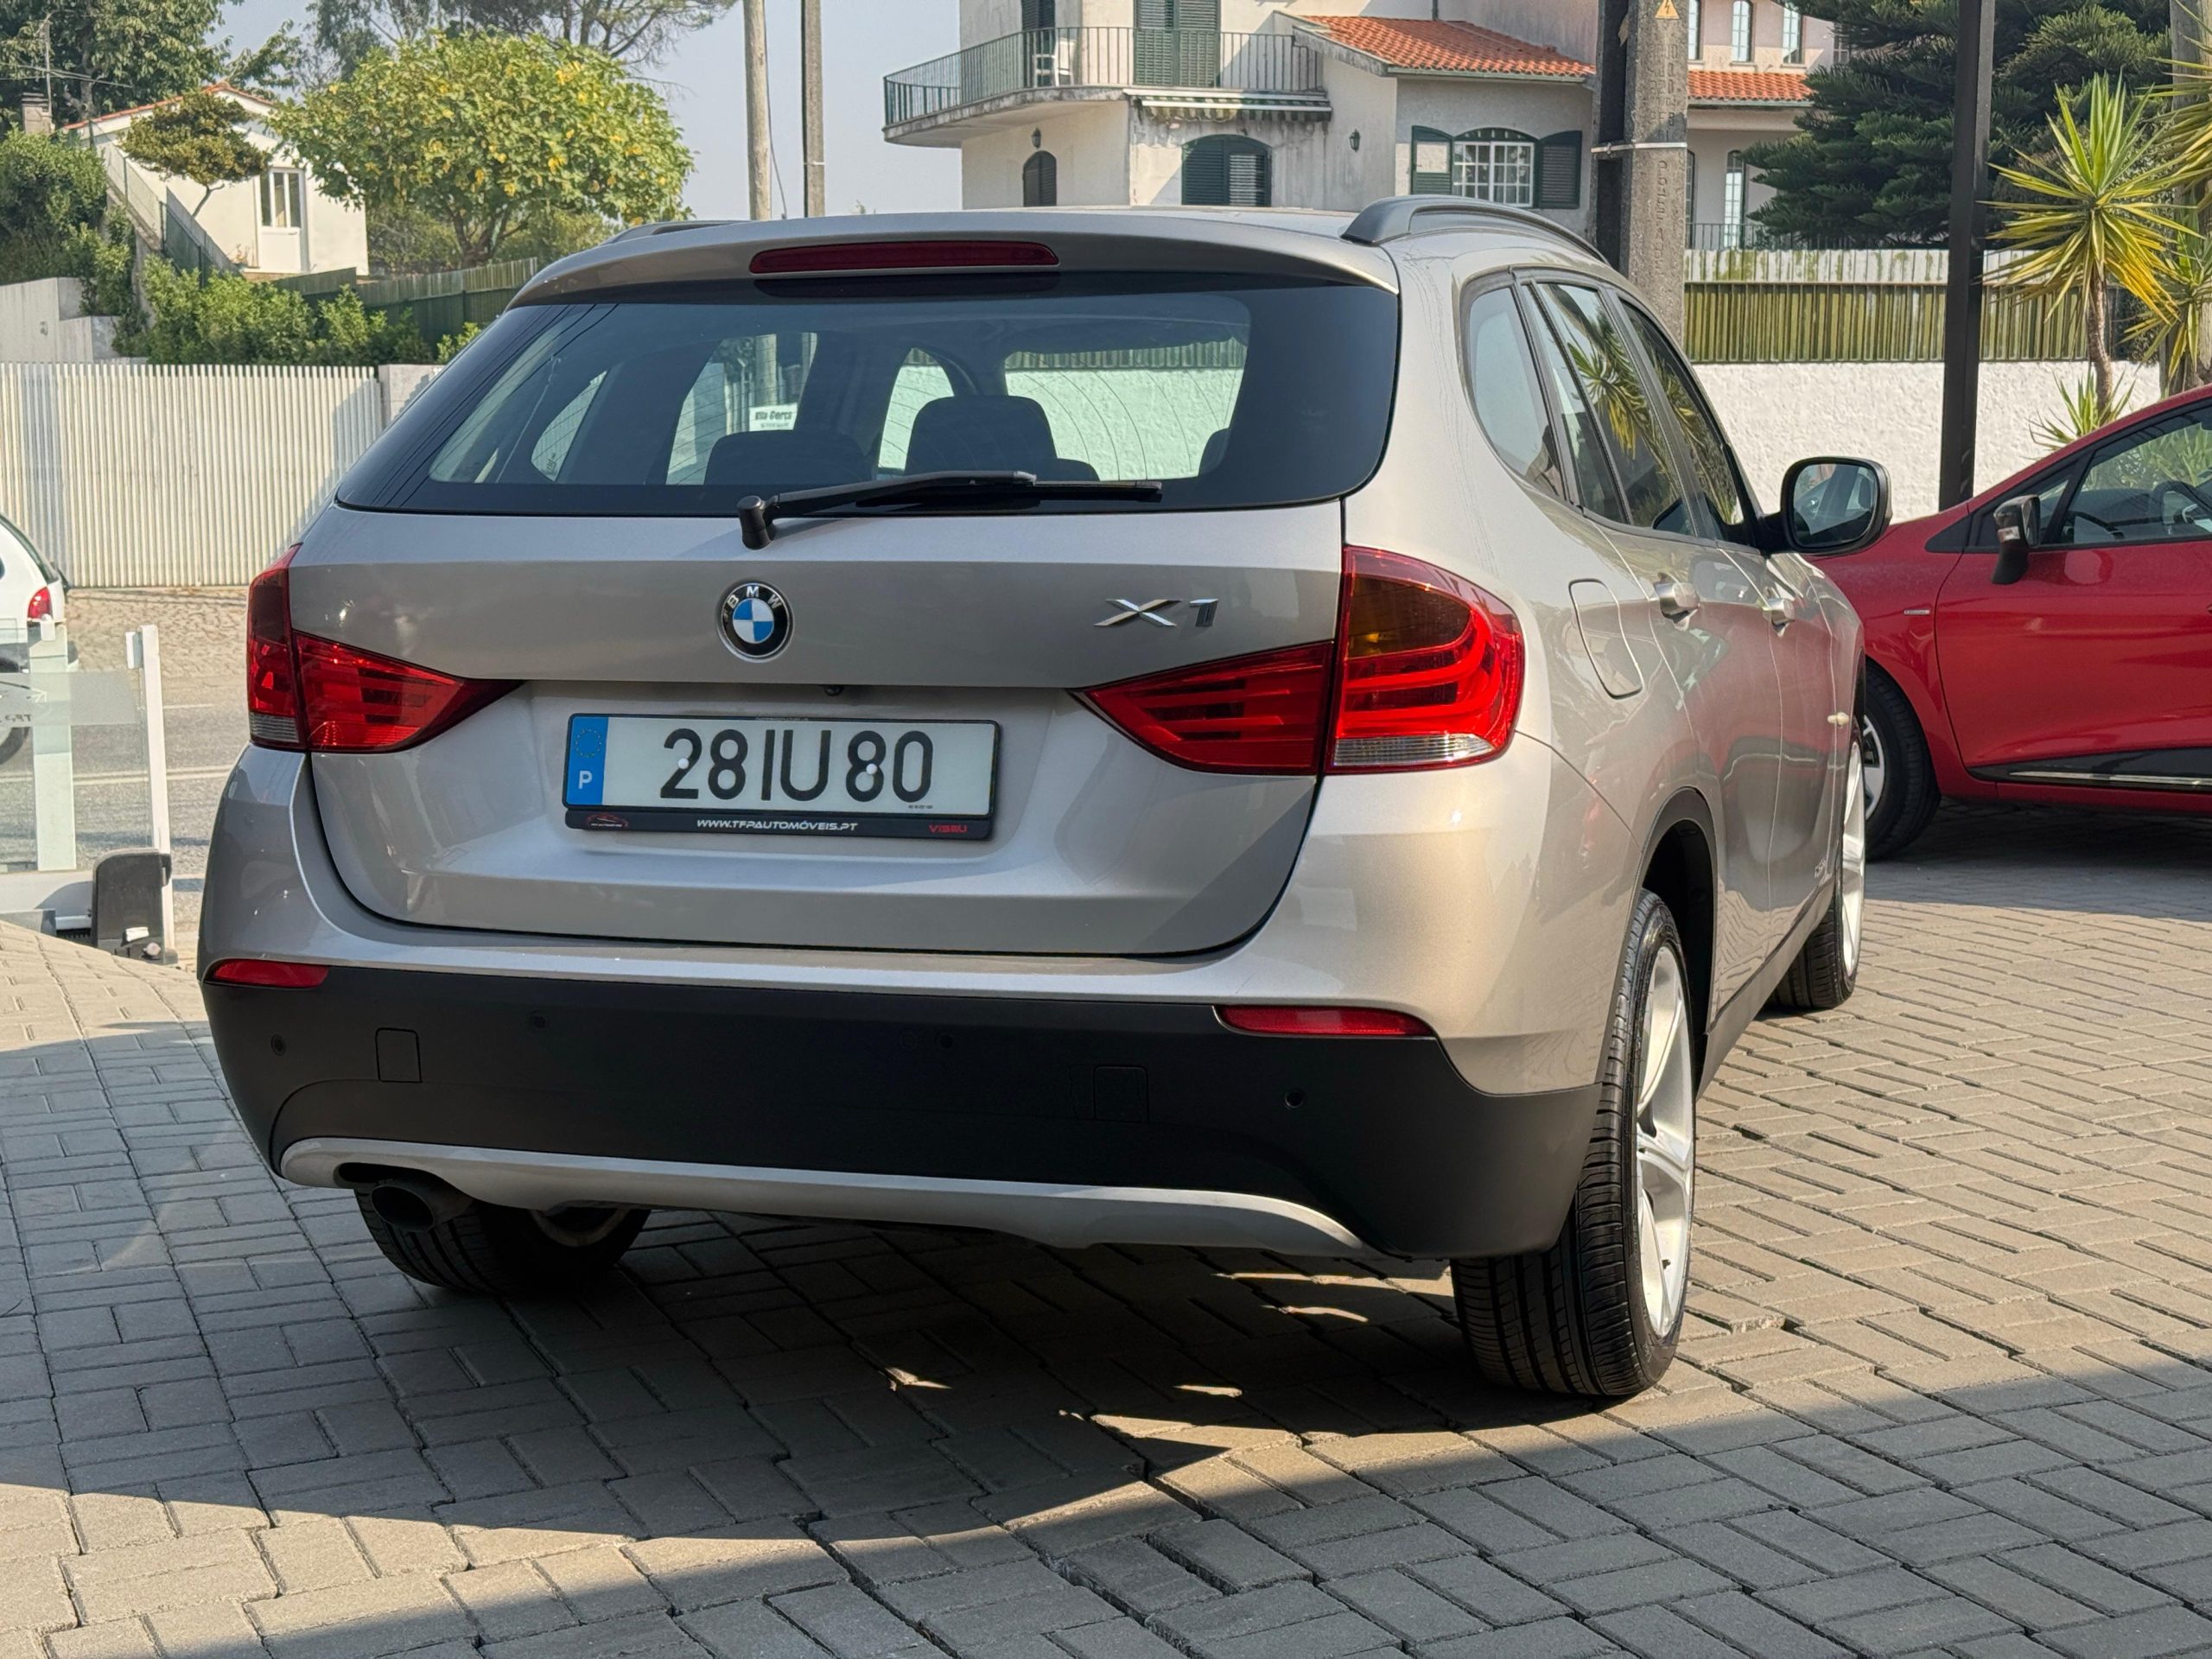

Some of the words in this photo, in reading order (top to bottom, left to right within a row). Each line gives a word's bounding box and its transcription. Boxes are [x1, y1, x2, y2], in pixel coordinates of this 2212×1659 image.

[726, 585, 783, 609] BMW
[1093, 598, 1219, 627] X1
[578, 770, 593, 790] P
